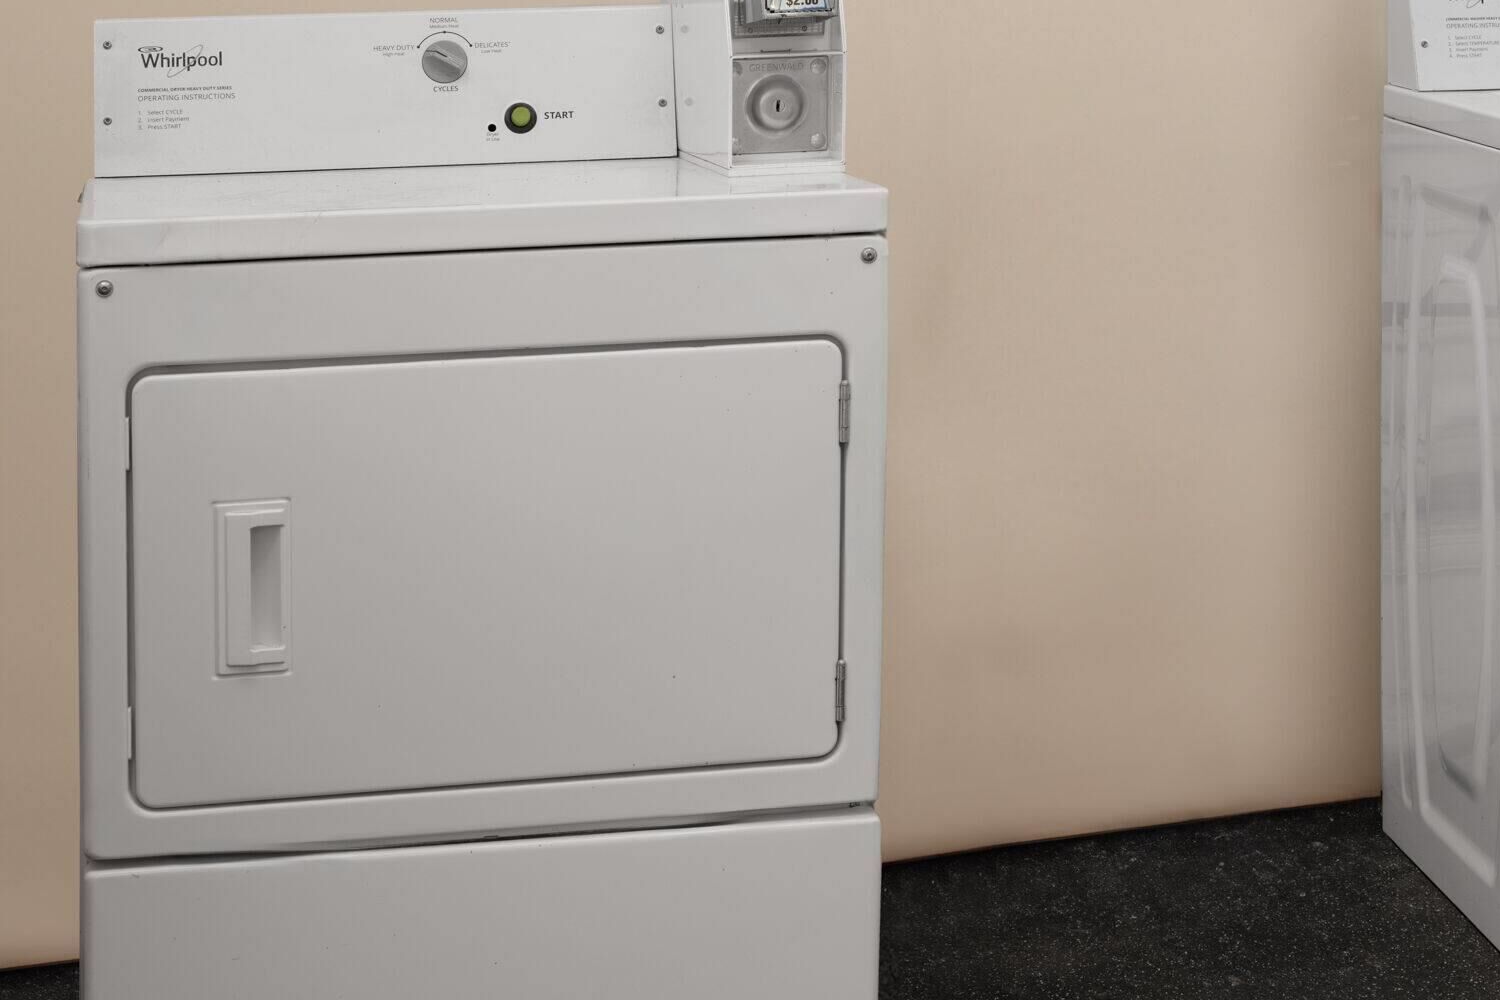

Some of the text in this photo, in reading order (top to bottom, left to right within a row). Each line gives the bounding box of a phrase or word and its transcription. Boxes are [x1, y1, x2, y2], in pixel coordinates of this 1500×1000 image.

[140, 51, 222, 72] Whirlpool
[748, 62, 804, 73] GREENWALD
[137, 92, 236, 102] OPERATING INSTRUCTIONS
[544, 110, 574, 120] START
